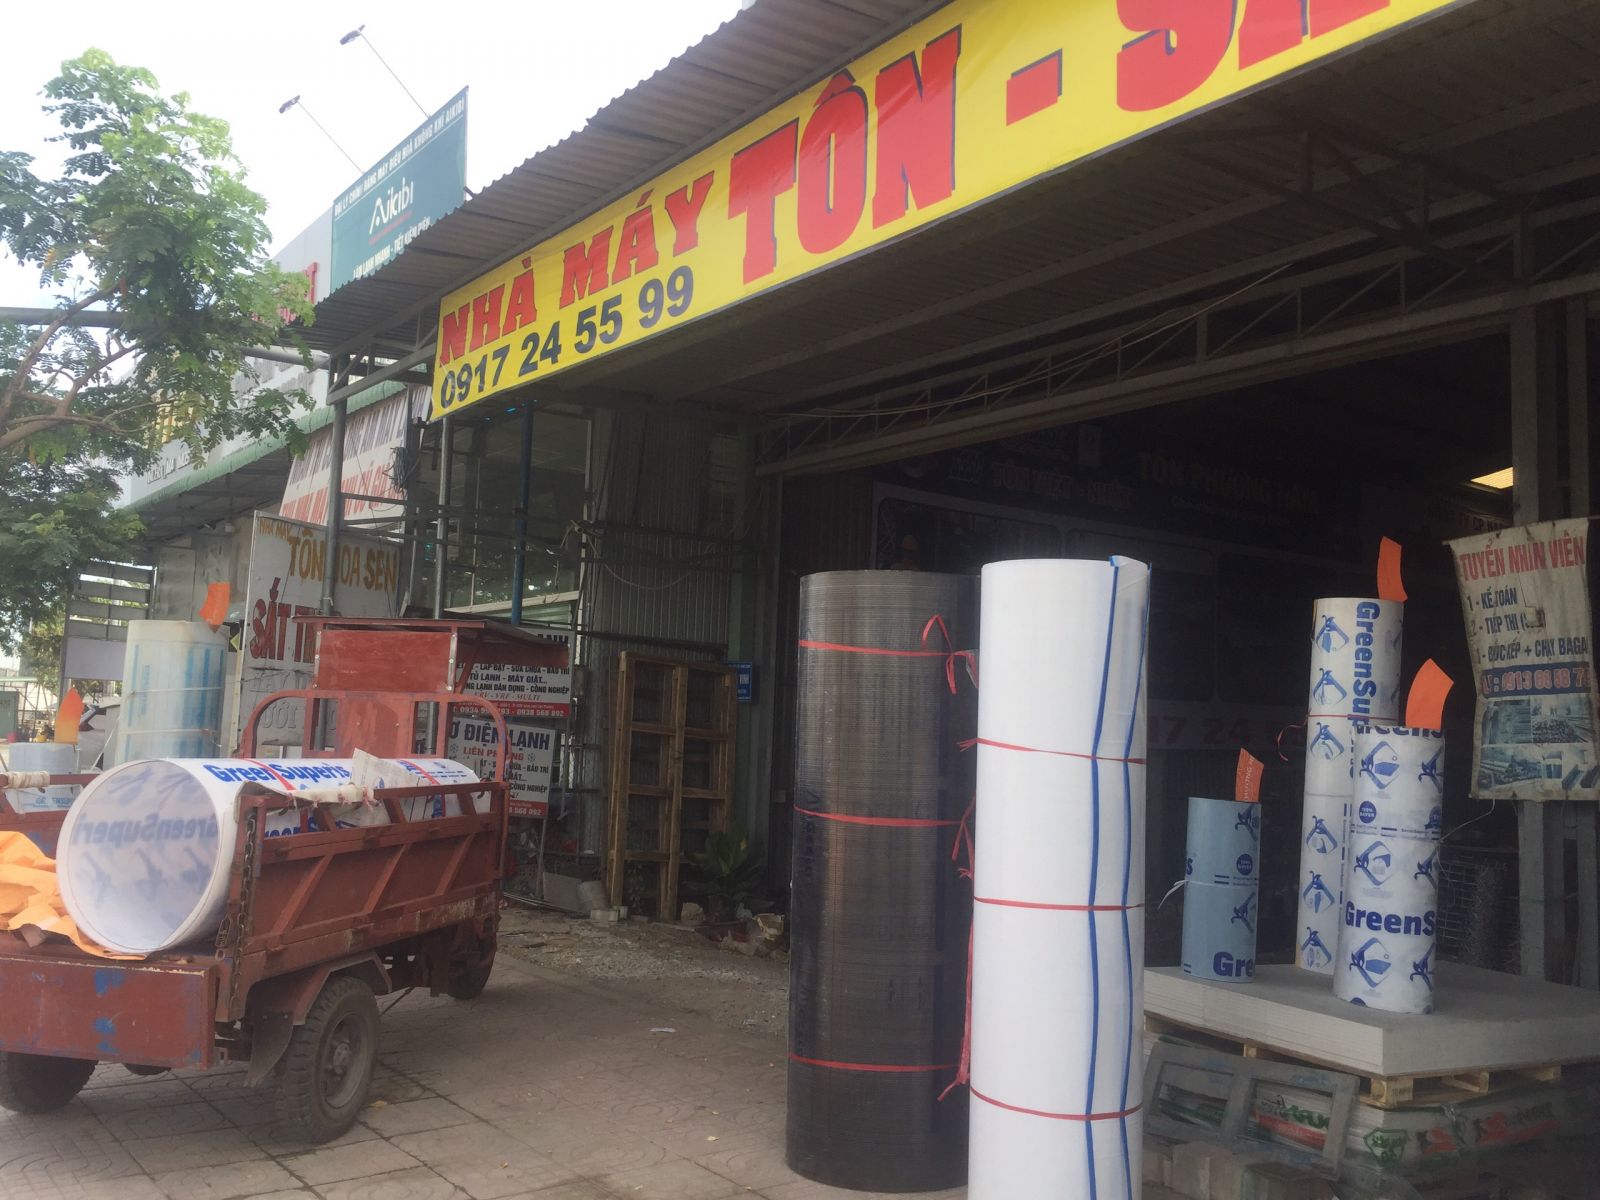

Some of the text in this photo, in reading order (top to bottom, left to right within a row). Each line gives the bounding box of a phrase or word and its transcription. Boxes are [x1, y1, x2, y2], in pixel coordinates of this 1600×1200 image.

[439, 256, 538, 368] NHÀ
[559, 189, 715, 309] MÁY
[728, 23, 962, 285] TÔN
[440, 344, 510, 409] 0917
[518, 320, 562, 378] 24
[574, 294, 623, 354] 55
[638, 265, 694, 330] 99
[364, 548, 397, 593] SEN
[1549, 532, 1585, 568] VIÊN
